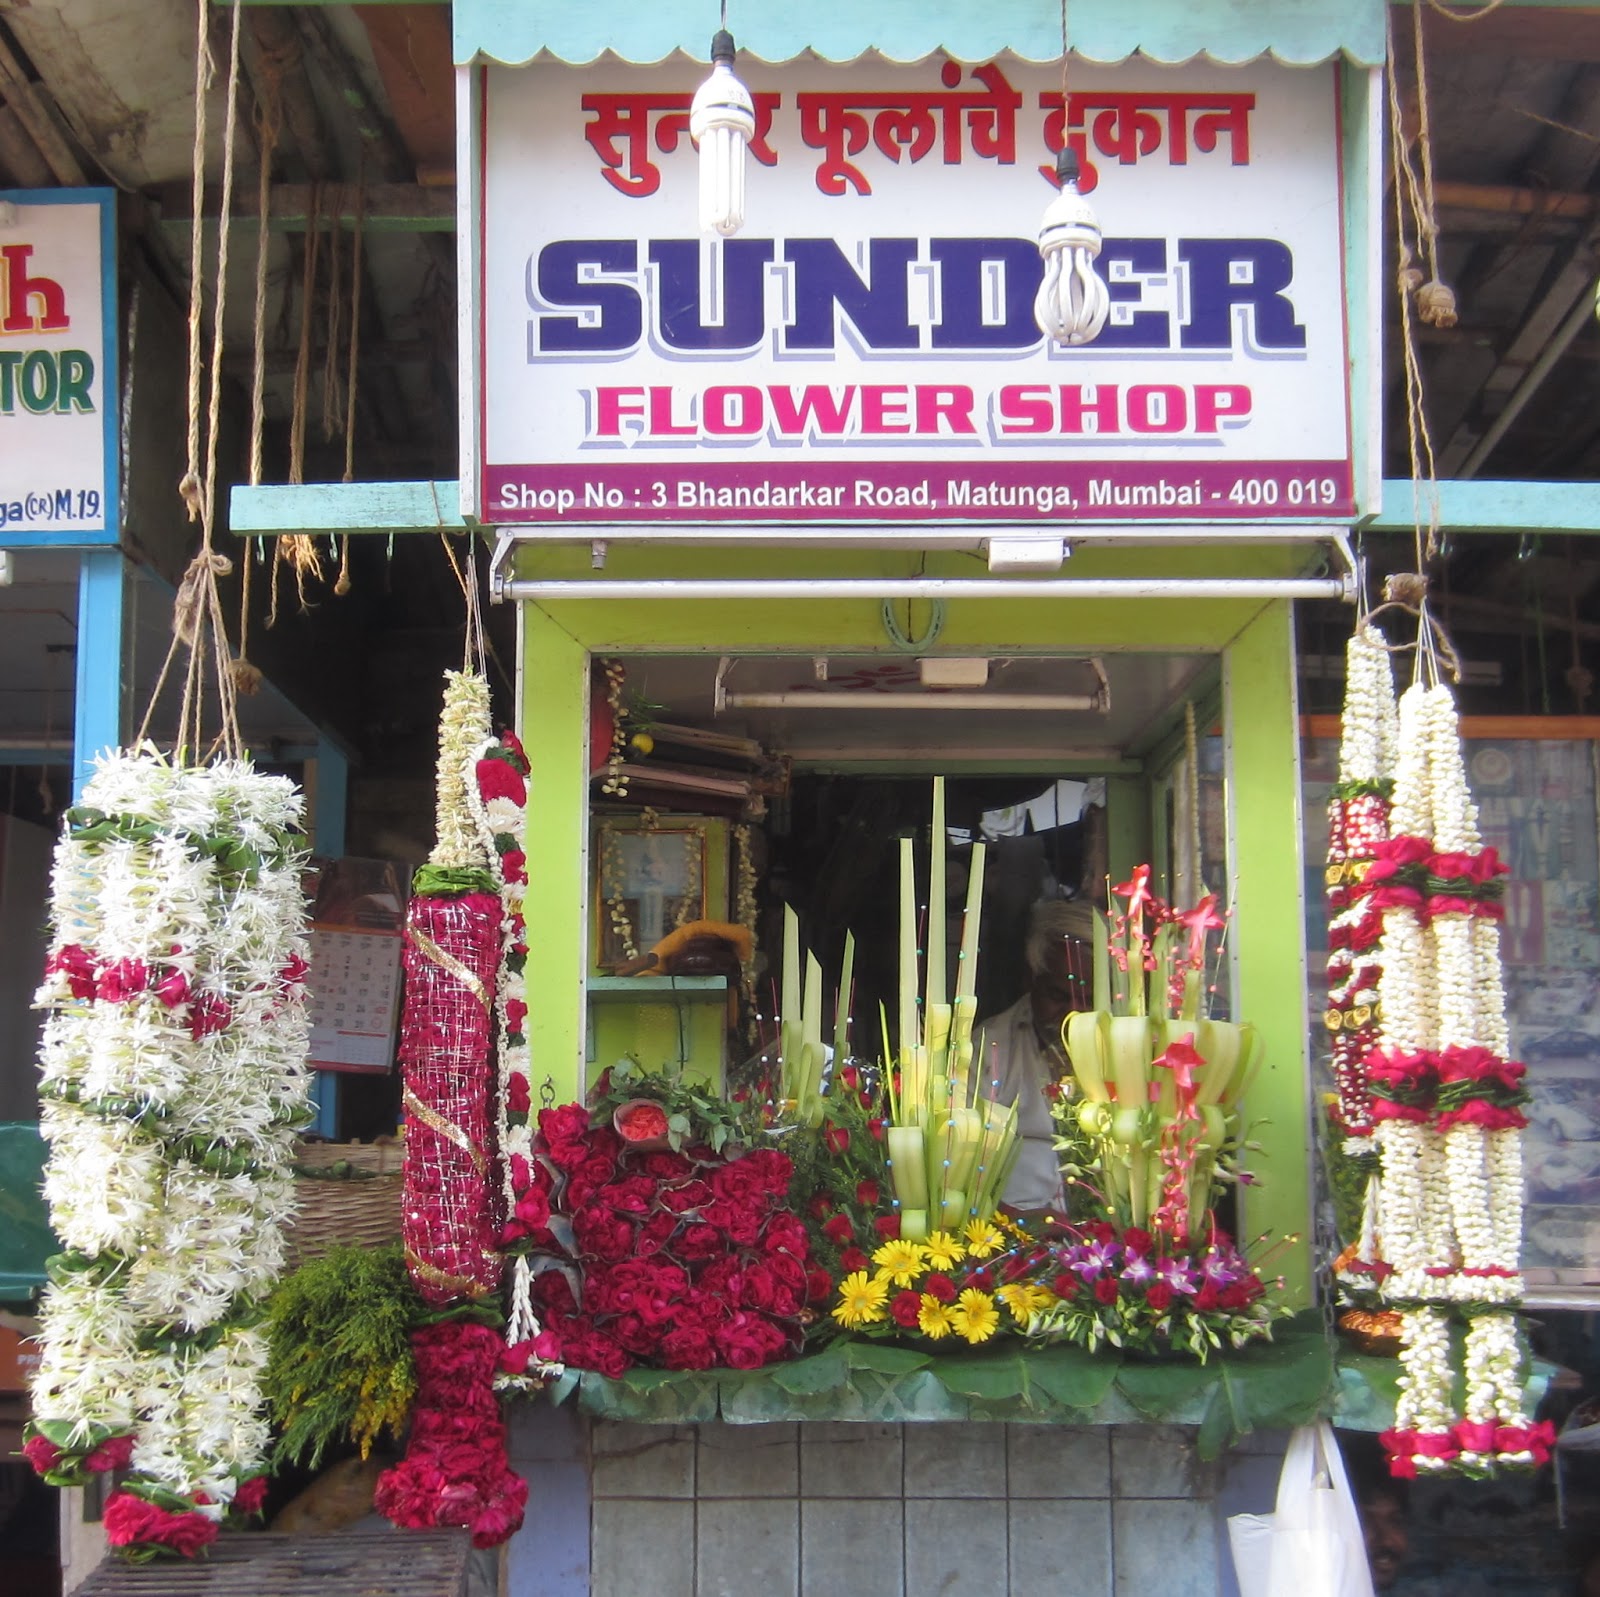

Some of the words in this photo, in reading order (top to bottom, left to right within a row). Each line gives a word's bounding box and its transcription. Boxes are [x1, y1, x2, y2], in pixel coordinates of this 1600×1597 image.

[797, 60, 1023, 196] फूलांचे
[1039, 92, 1256, 196] दुकान
[530, 237, 1307, 356] SUNDER
[592, 384, 978, 439] FLOWER
[998, 384, 1252, 438] SHOP
[500, 483, 575, 514] Shop
[583, 482, 624, 509] No
[652, 482, 668, 509] 3
[677, 480, 846, 508] Bhandarkar
[855, 480, 938, 510] Road,
[947, 479, 1079, 512] Matunga,
[1088, 479, 1202, 506] Mumbai
[1229, 479, 1279, 505] 400
[1287, 479, 1337, 505] 019
